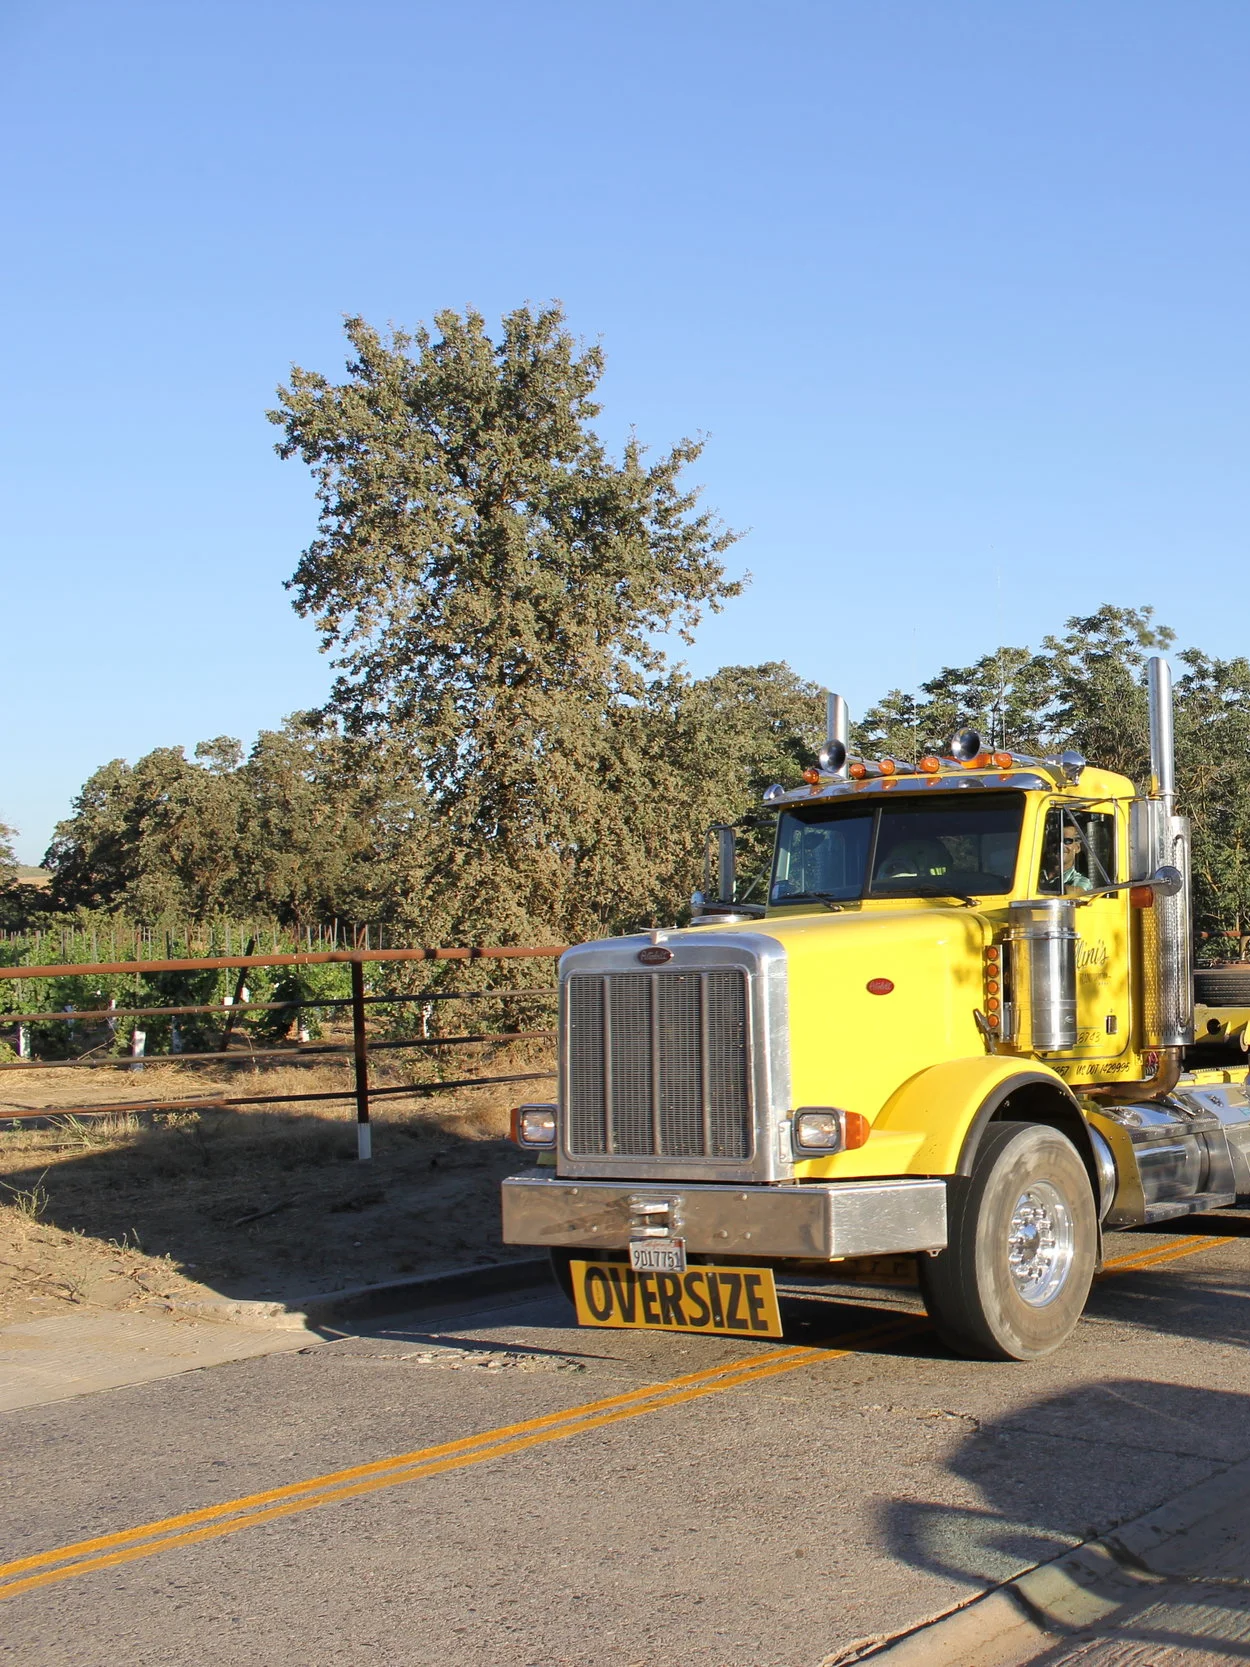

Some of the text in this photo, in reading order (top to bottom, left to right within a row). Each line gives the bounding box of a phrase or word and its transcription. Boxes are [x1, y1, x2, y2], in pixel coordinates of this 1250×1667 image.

[1086, 1063, 1100, 1075] DOT
[634, 1250, 682, 1268] 9D17751
[584, 1266, 769, 1331] OVERSIZE
